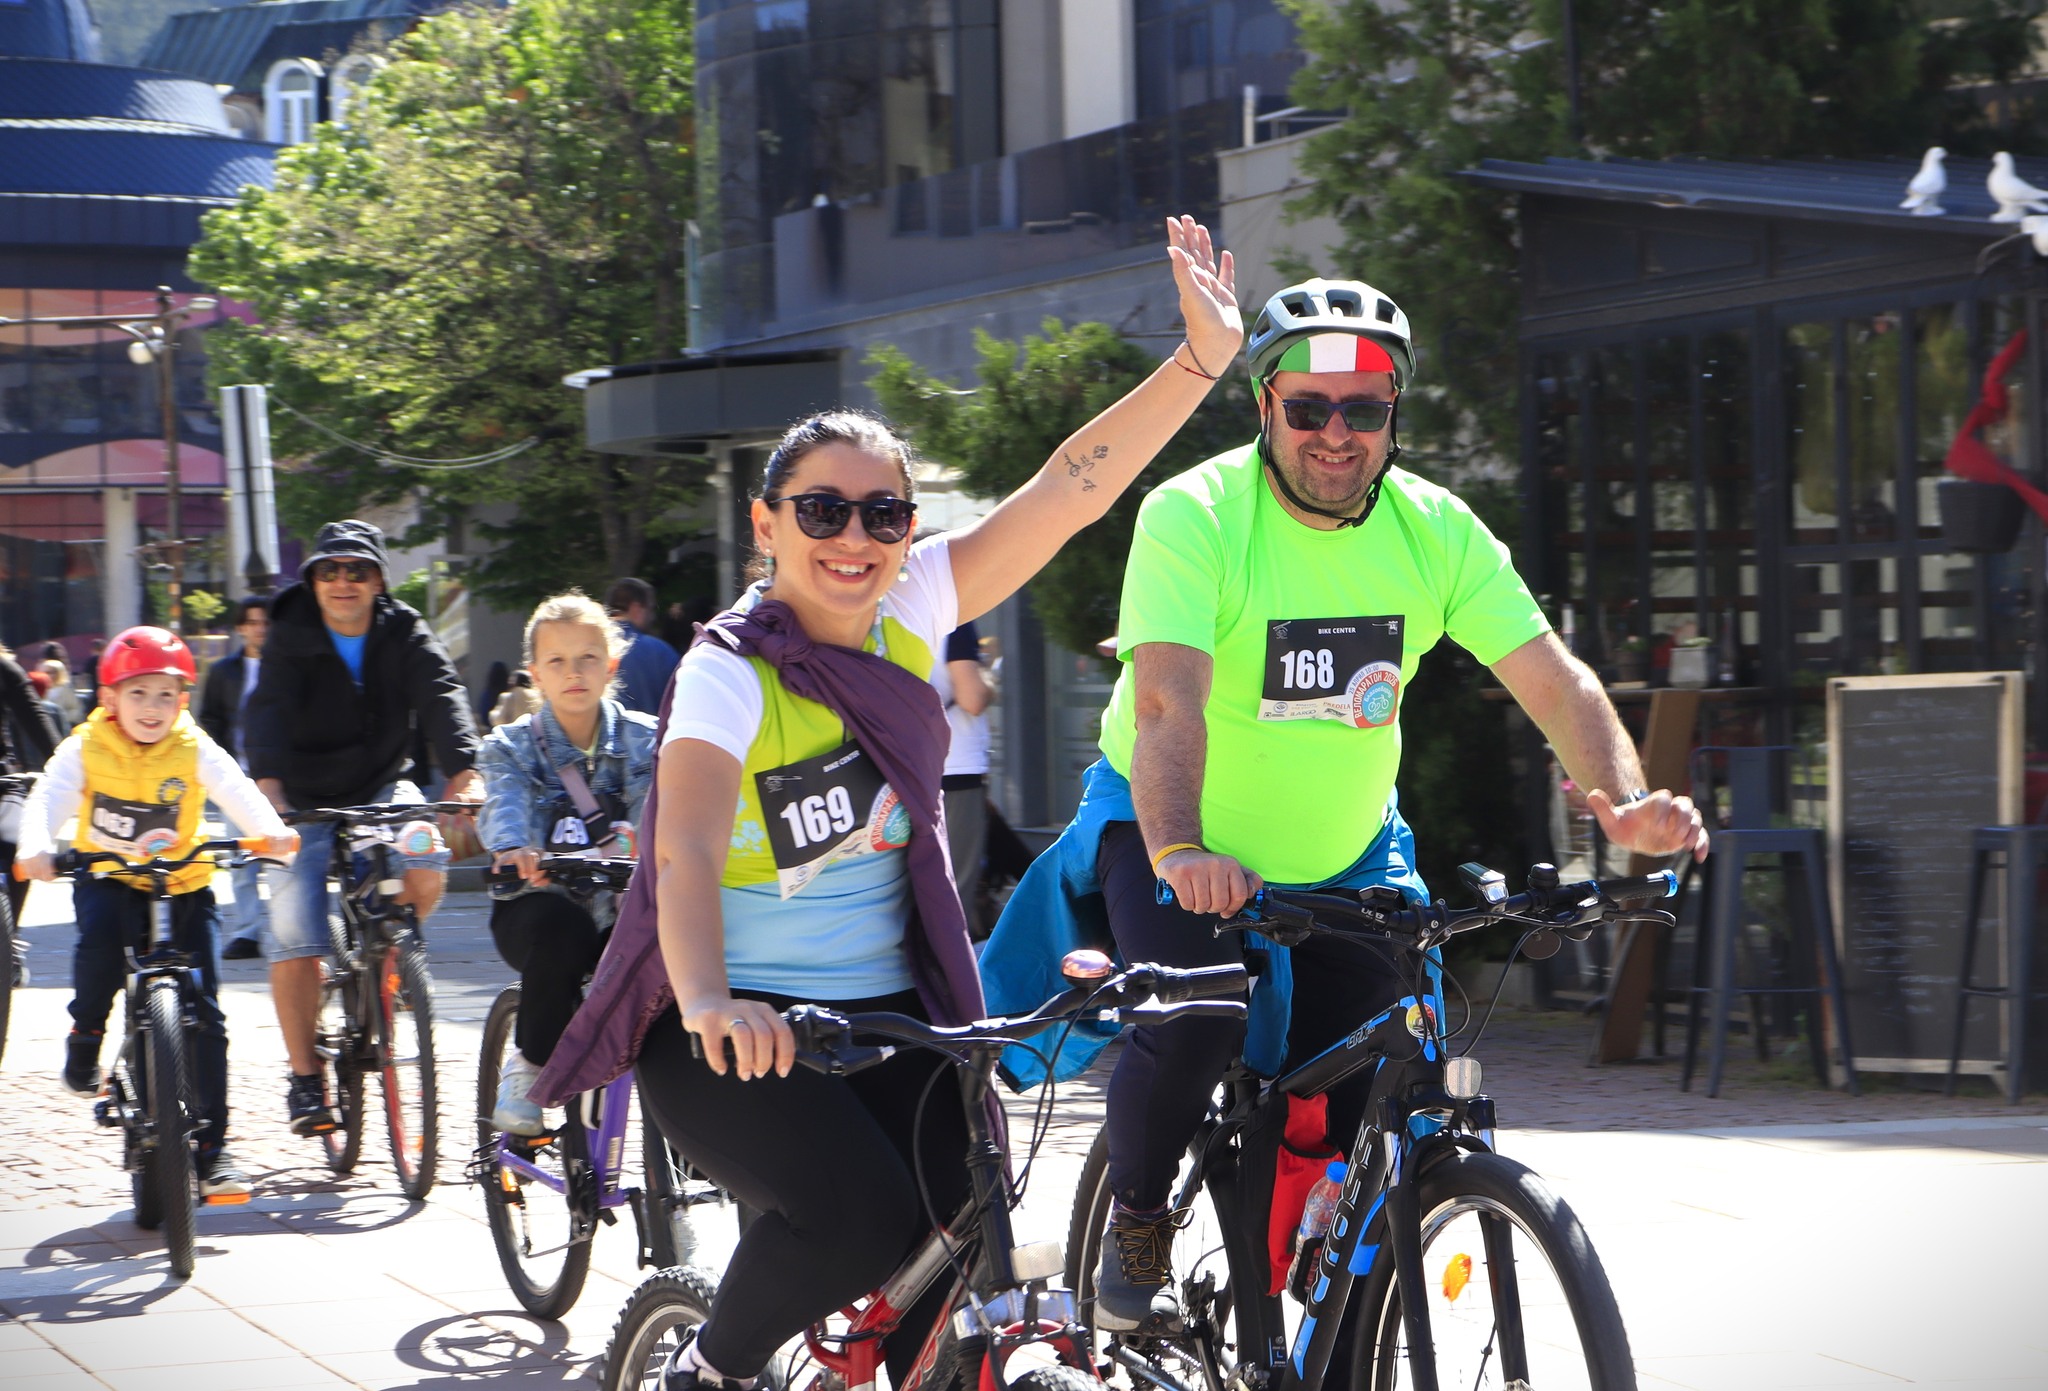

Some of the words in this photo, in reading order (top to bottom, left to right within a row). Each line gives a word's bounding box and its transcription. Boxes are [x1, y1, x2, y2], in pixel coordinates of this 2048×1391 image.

[1280, 648, 1335, 690] 168
[1354, 671, 1383, 719] ВЕЛОМАРАТОН
[779, 785, 856, 849] 169
